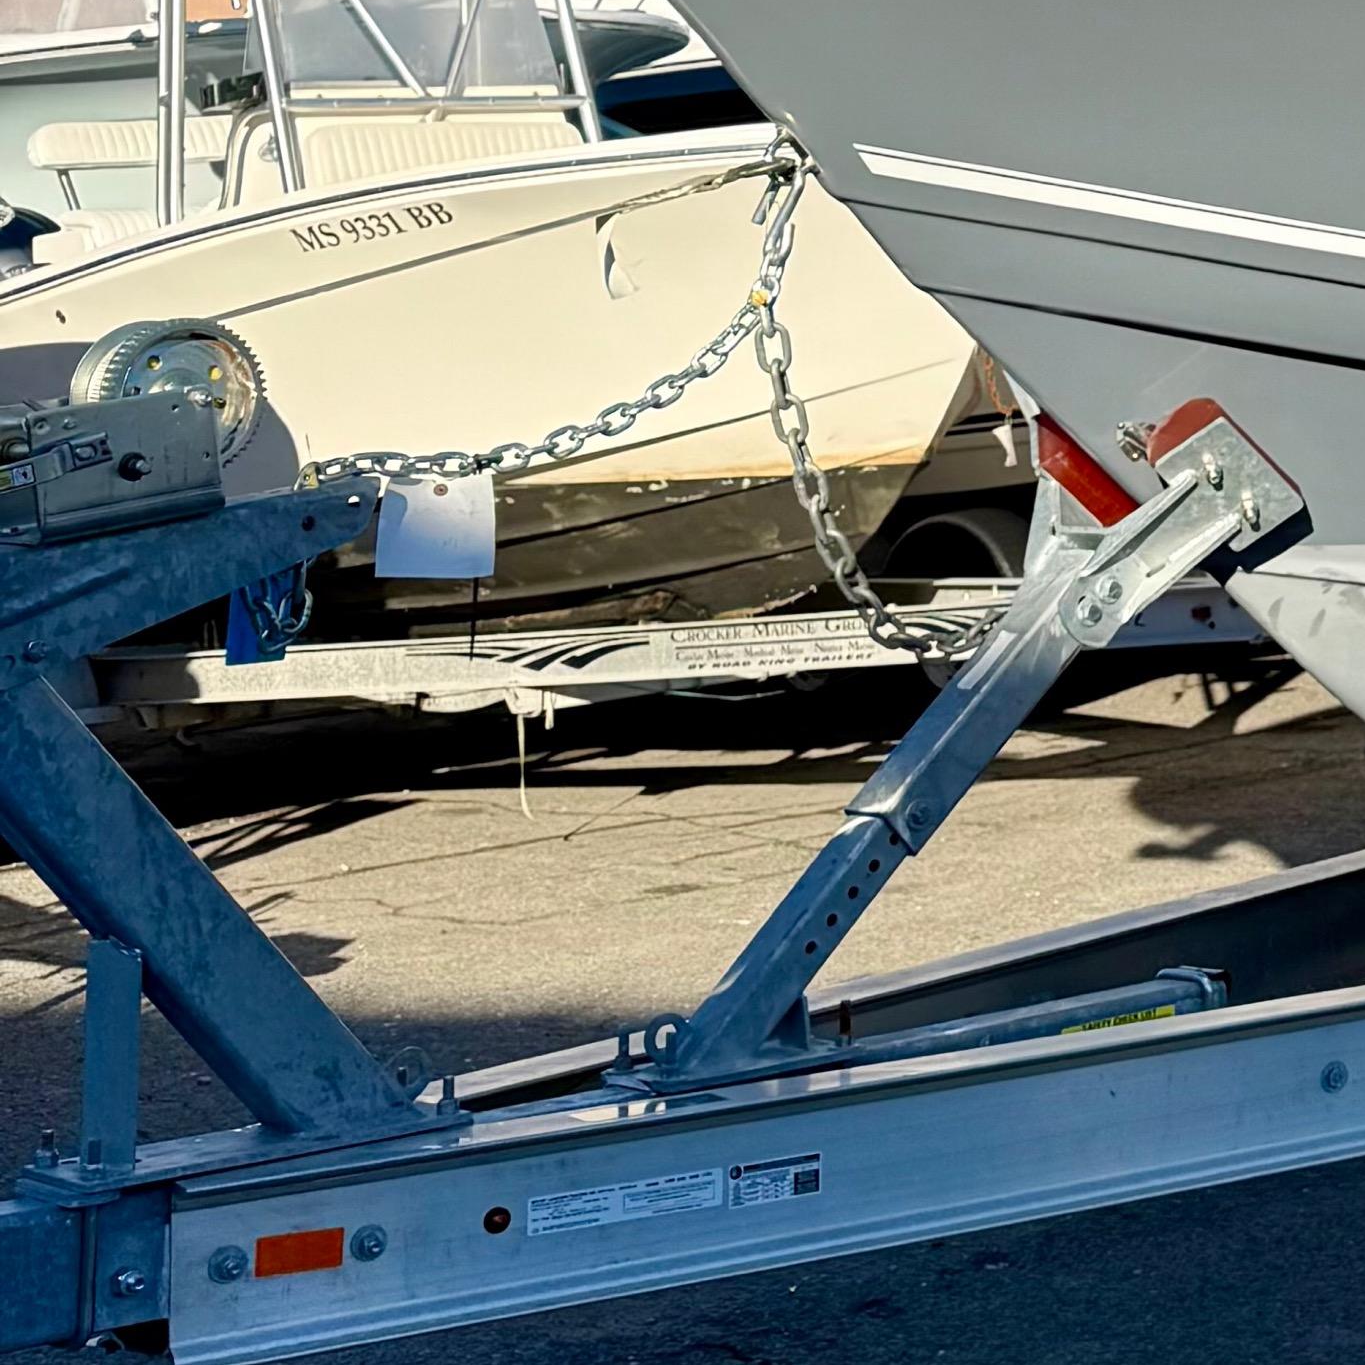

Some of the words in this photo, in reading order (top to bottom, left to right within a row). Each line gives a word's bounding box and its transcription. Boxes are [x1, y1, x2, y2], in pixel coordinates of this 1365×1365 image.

[289, 222, 340, 252] MS
[339, 211, 408, 243] 9331
[402, 201, 453, 229] BB
[671, 626, 742, 643] CROCKER
[752, 621, 817, 639] MARINE
